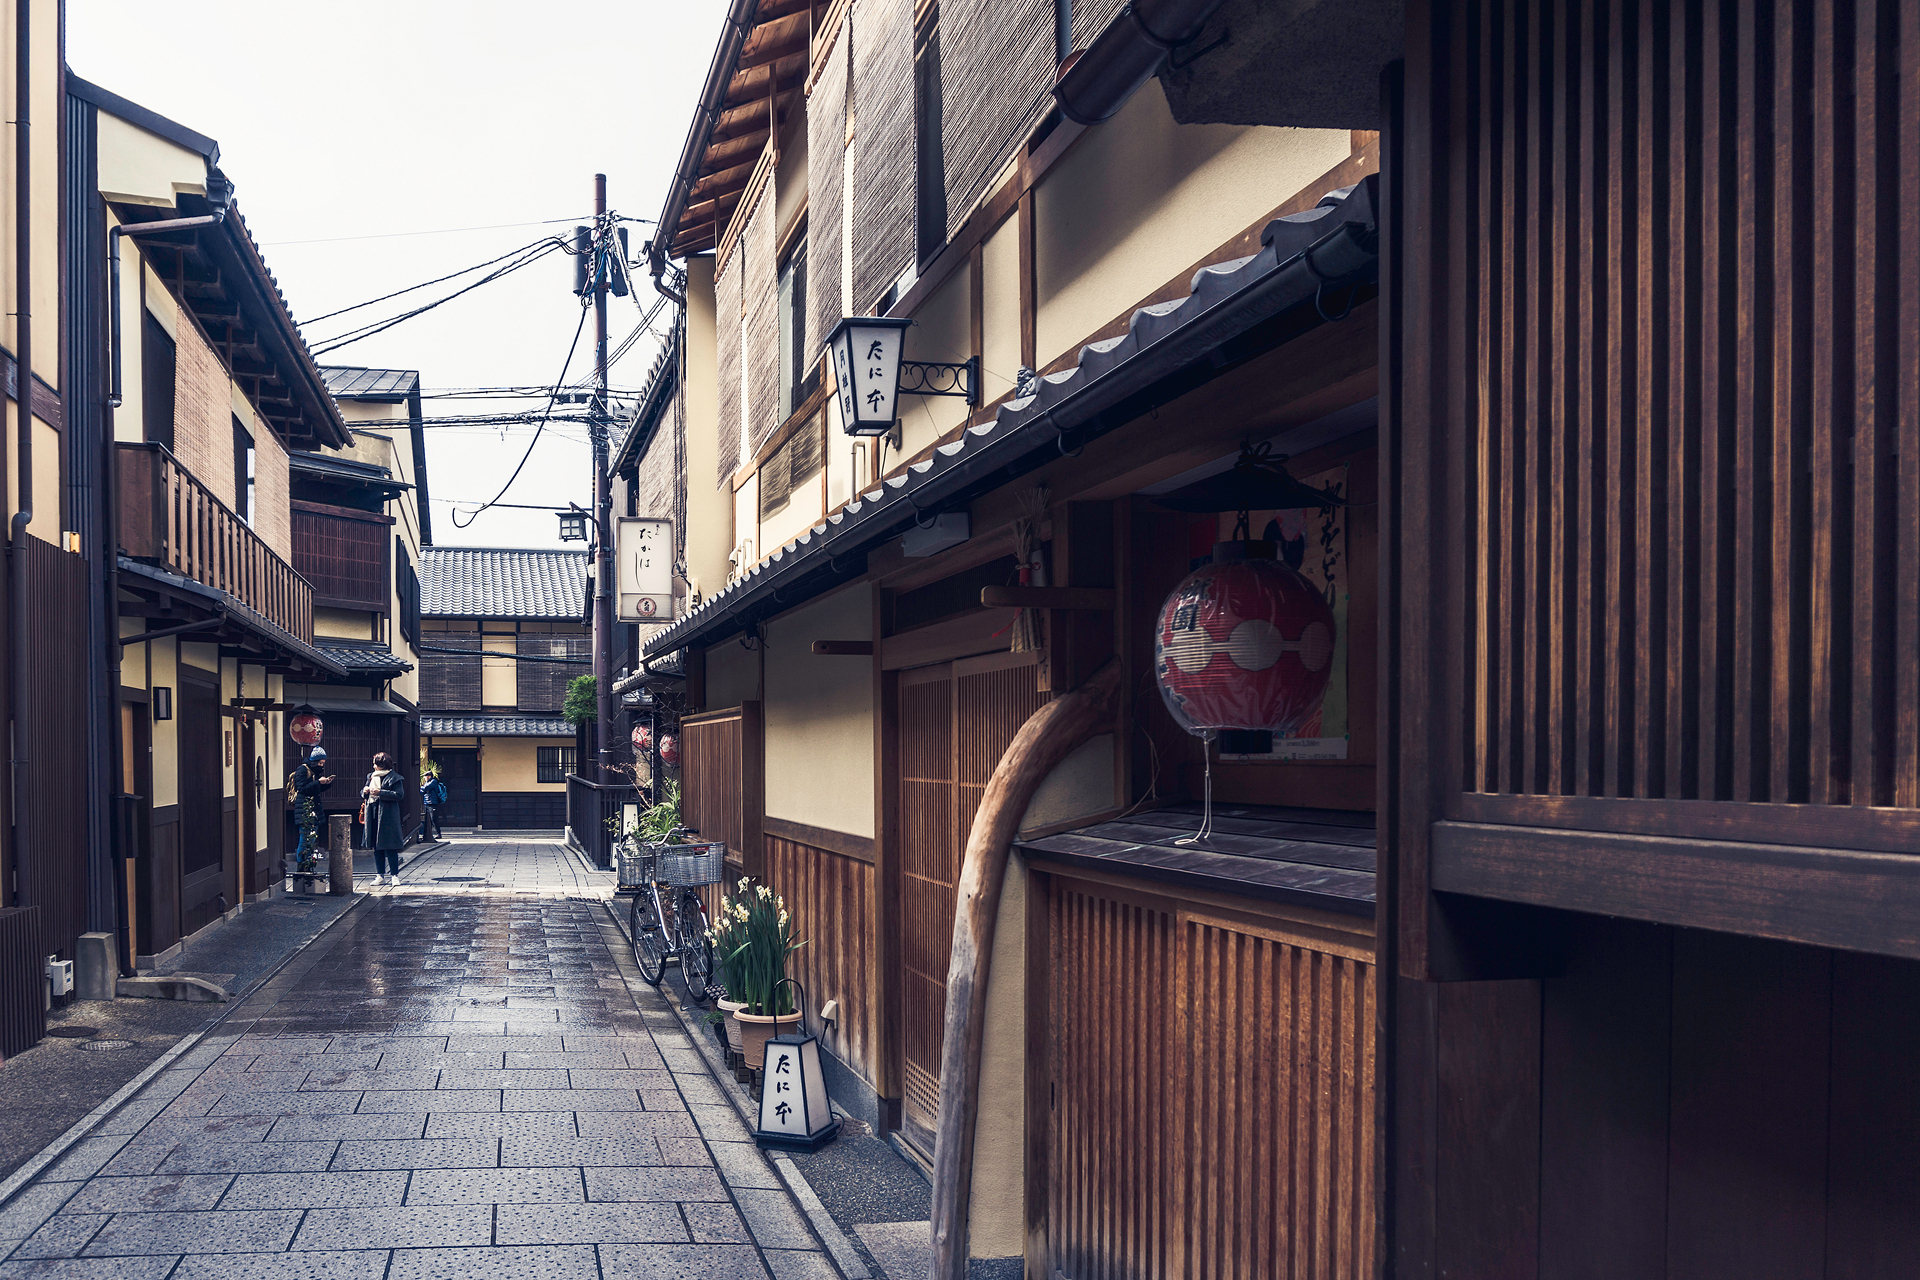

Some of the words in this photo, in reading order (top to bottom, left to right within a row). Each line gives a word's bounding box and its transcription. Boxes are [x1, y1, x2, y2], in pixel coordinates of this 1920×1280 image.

[867, 340, 885, 413] たに本
[635, 528, 652, 592] たかはし
[775, 1054, 792, 1125] たに本
